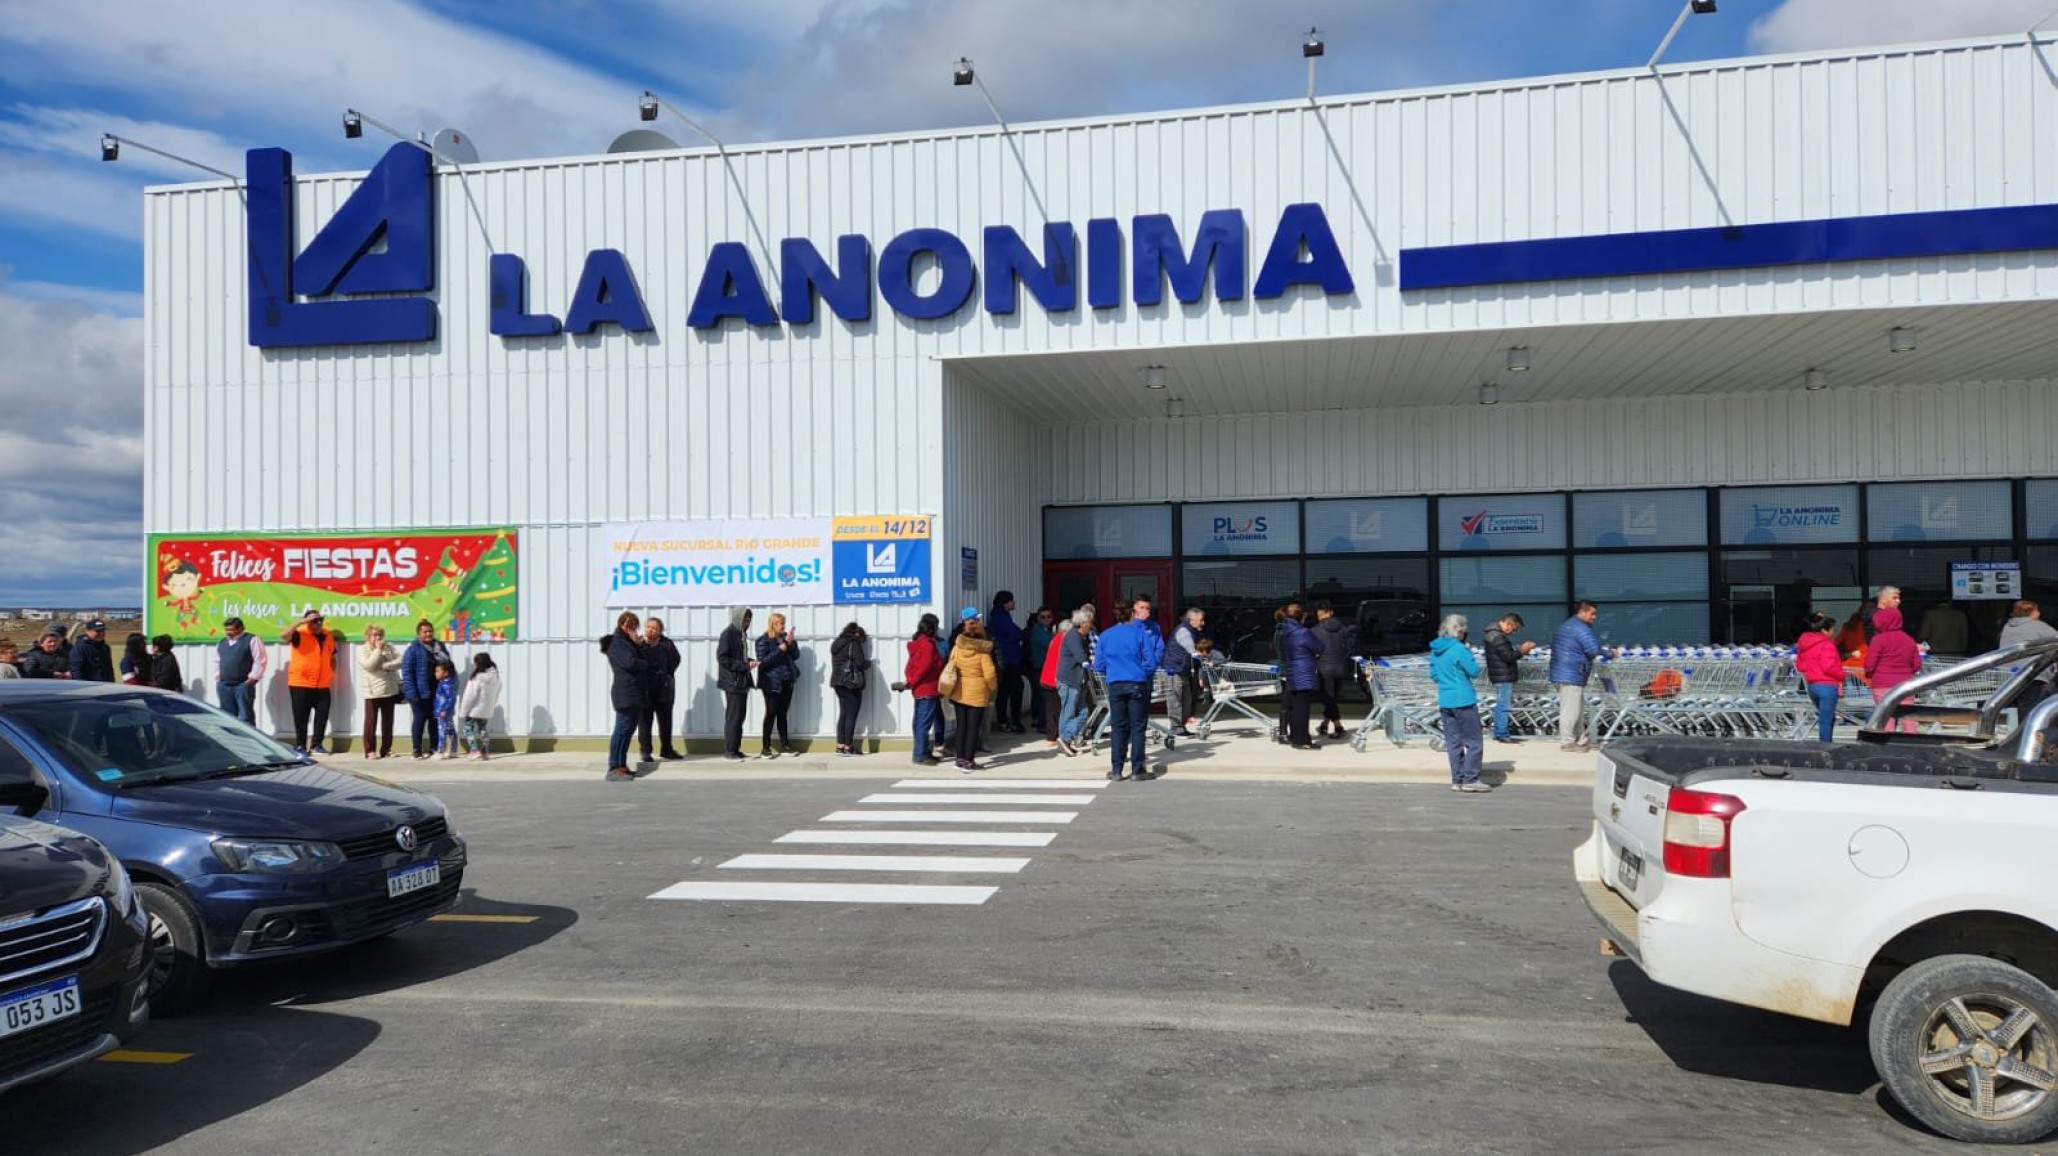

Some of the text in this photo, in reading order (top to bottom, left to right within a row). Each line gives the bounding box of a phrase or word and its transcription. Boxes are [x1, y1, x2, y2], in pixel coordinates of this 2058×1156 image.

[490, 202, 1355, 336] LA ANONIMA
[884, 520, 926, 535] 14/12
[1213, 516, 1268, 533] PLUS
[1778, 515, 1840, 525] ONLINE
[613, 541, 658, 552] NUEVA
[662, 539, 732, 551] SUCURSAL
[763, 537, 820, 549] GRANDE
[210, 547, 418, 581] Felices FIESTAS
[612, 557, 821, 591] ¡Bienvenidos!
[842, 576, 920, 588] LA ANONIMA
[223, 600, 239, 617] les
[243, 600, 279, 618] desea
[321, 602, 409, 617] ANONIMA
[7, 998, 44, 1029] 053
[52, 989, 76, 1015] JS
